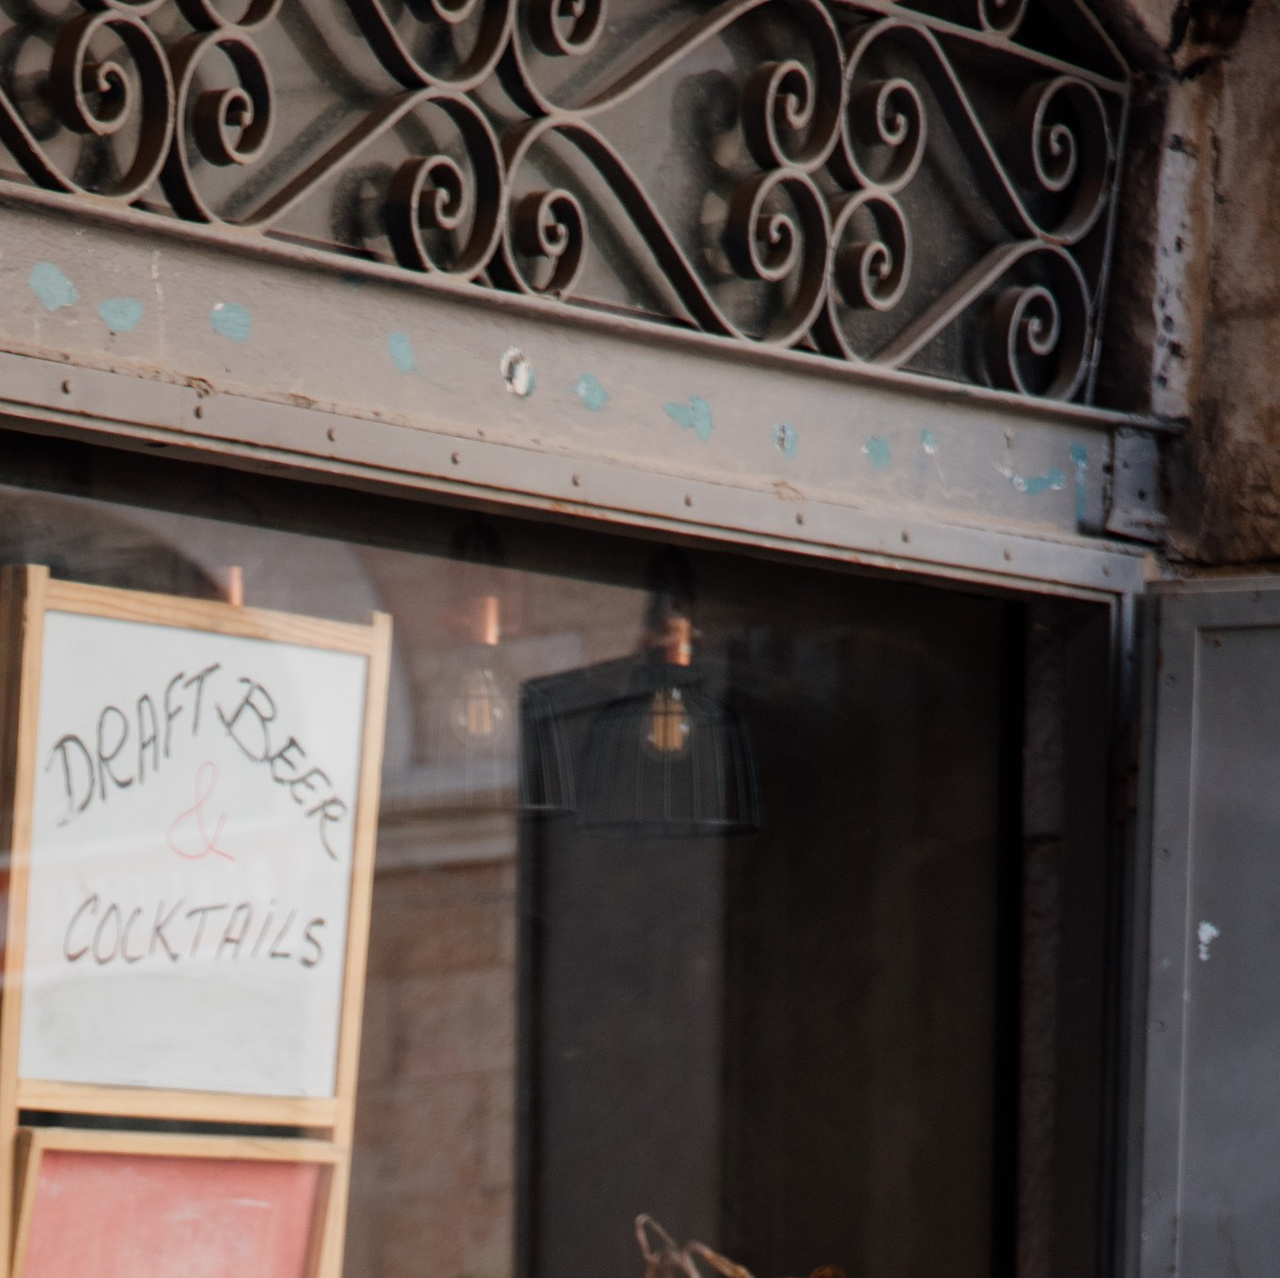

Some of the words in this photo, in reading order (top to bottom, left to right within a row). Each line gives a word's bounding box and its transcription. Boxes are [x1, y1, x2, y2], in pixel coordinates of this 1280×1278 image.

[46, 663, 223, 828] DRAFT
[216, 676, 349, 861] BEER
[166, 761, 235, 860] &
